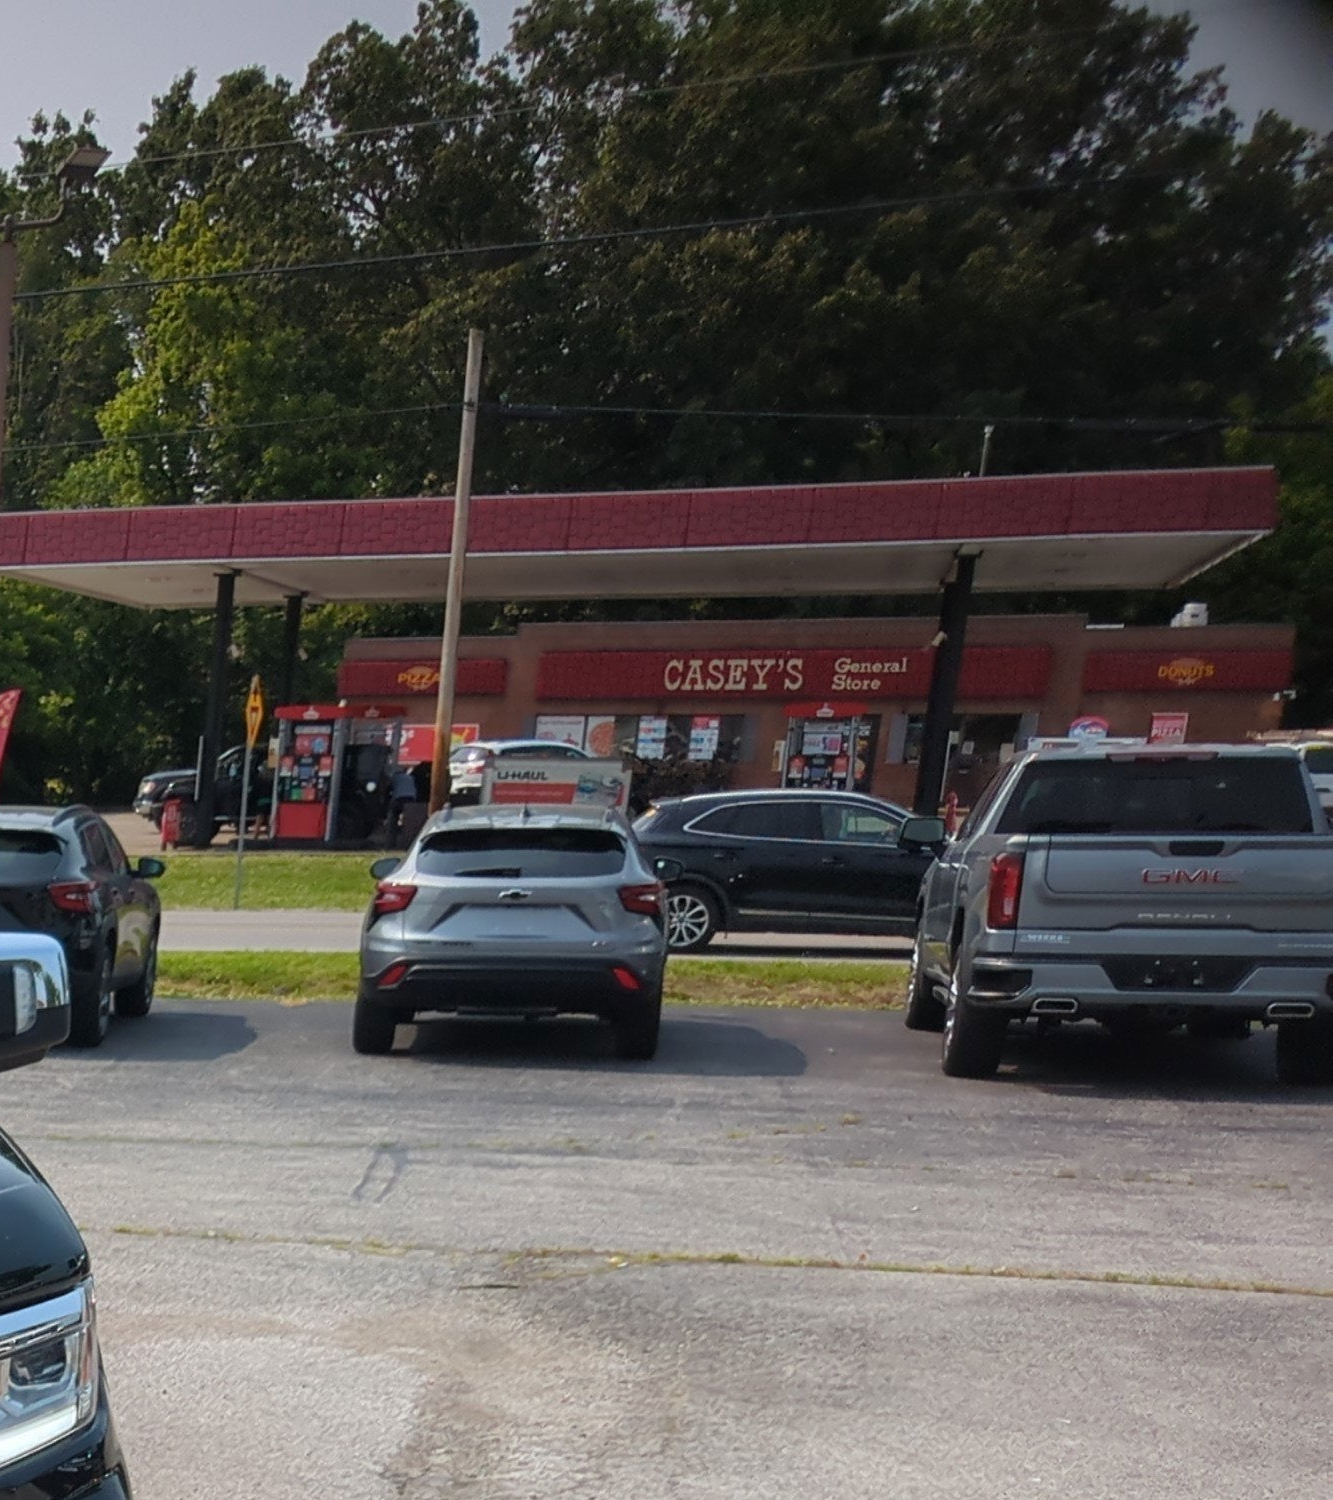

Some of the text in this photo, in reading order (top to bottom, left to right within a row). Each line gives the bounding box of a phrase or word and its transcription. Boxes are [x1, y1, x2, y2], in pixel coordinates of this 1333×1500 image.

[834, 657, 908, 673] General
[1158, 664, 1215, 679] DONUTS
[664, 658, 803, 691] CASEY'S
[831, 674, 881, 690] Store
[497, 770, 549, 781] U-HAUL
[1141, 867, 1244, 884] GMC
